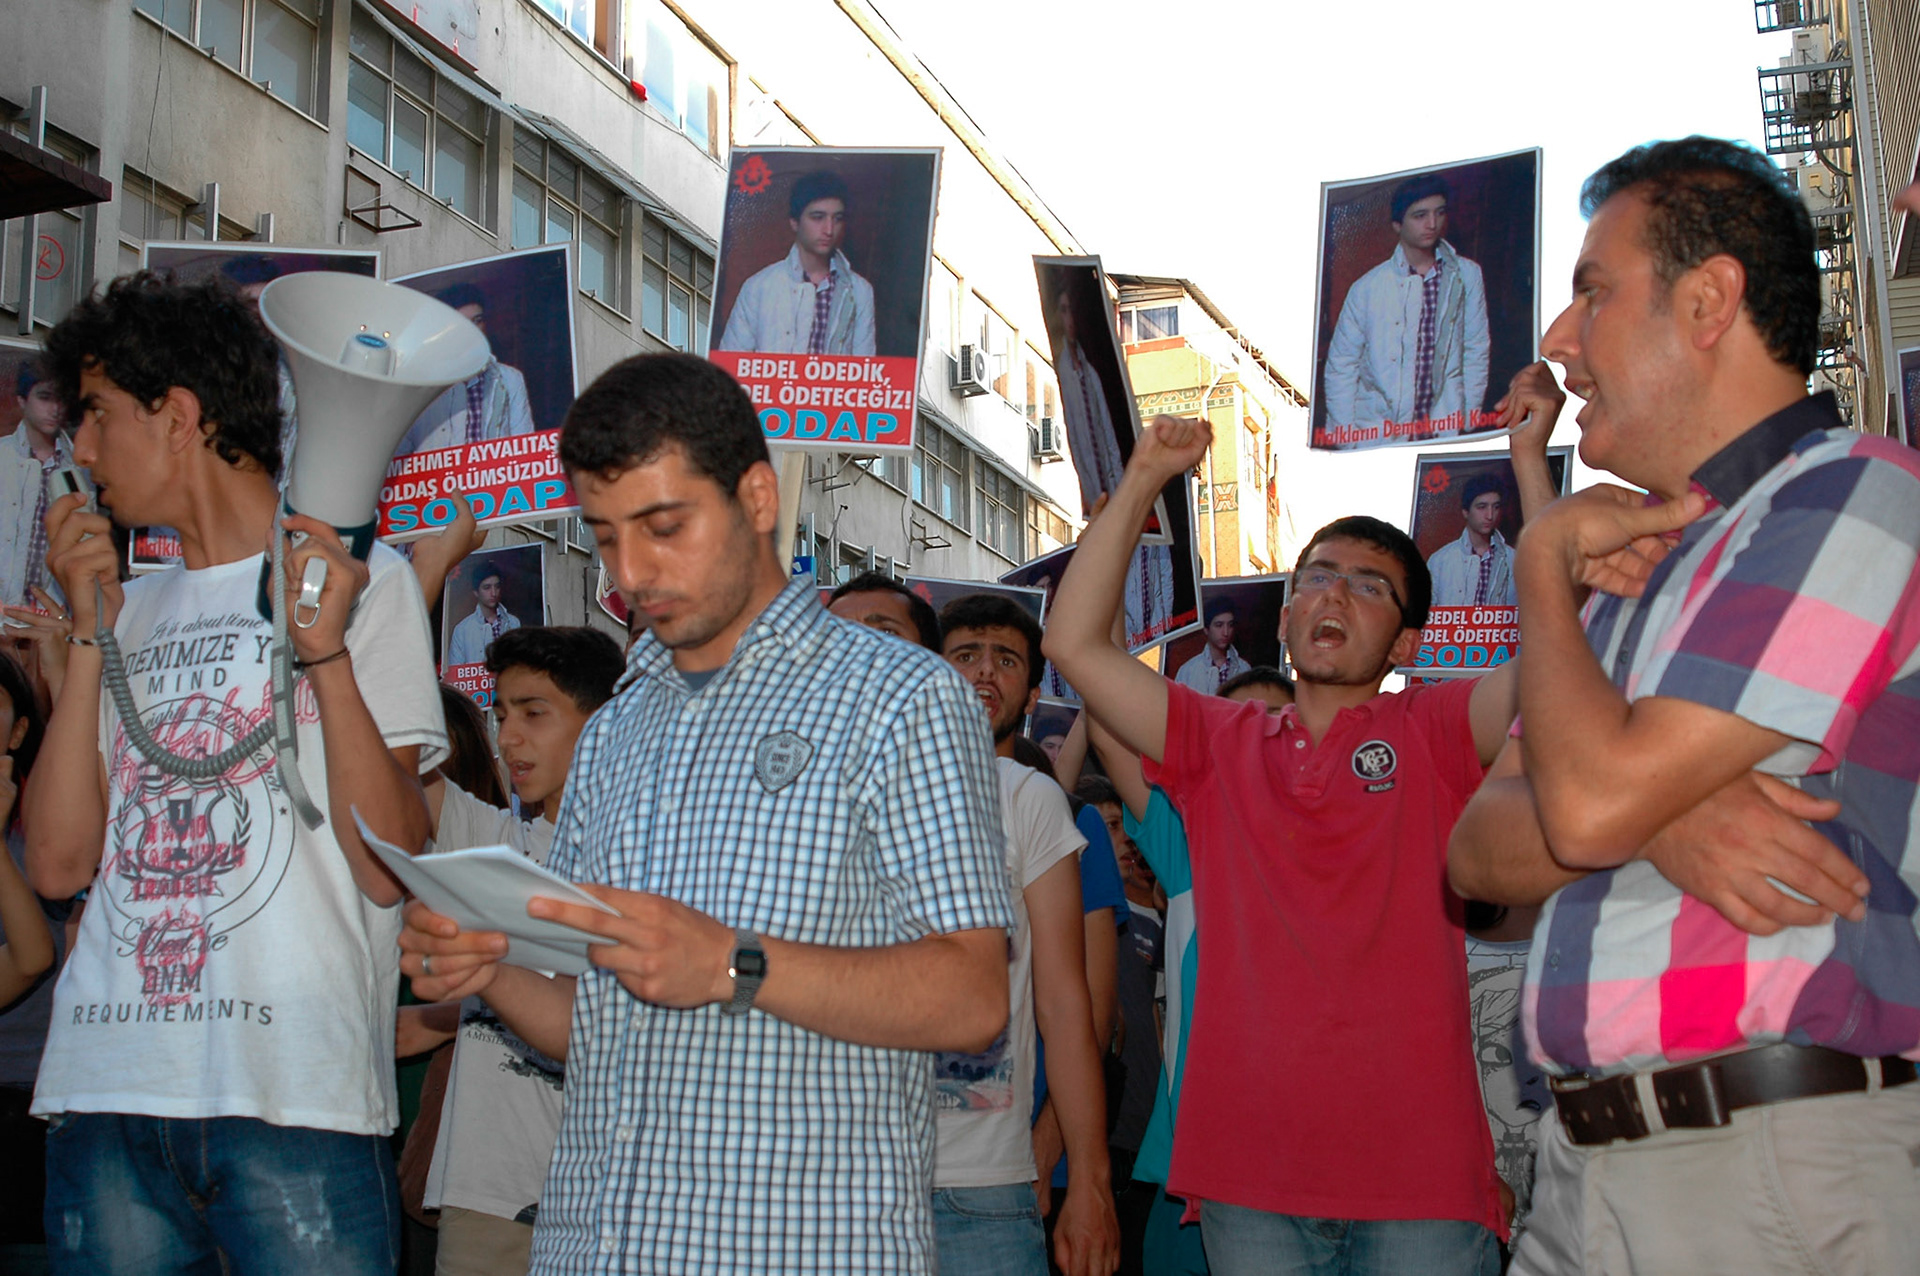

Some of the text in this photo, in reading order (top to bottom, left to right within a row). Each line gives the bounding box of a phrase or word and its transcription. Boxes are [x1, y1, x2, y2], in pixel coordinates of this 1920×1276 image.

[737, 356, 891, 386] BEDEL ÖDEDİK,
[779, 381, 912, 410] ÖDETECEĞİZ!
[757, 407, 898, 442] ODAP
[1314, 425, 1379, 446] Halkların
[1383, 409, 1465, 438] Demokratik
[387, 432, 561, 478] MEHMET AYVALITAŞ
[379, 478, 438, 503] OLDAŞ
[387, 479, 567, 532] SODAP
[181, 612, 224, 634] about
[224, 612, 265, 629] time
[1472, 606, 1519, 625] ÖDEDİ
[1454, 625, 1521, 643] ÖDETECE
[1413, 645, 1521, 667] SODA
[147, 668, 227, 695] MIND
[72, 999, 273, 1026] REQUIREMENTS
